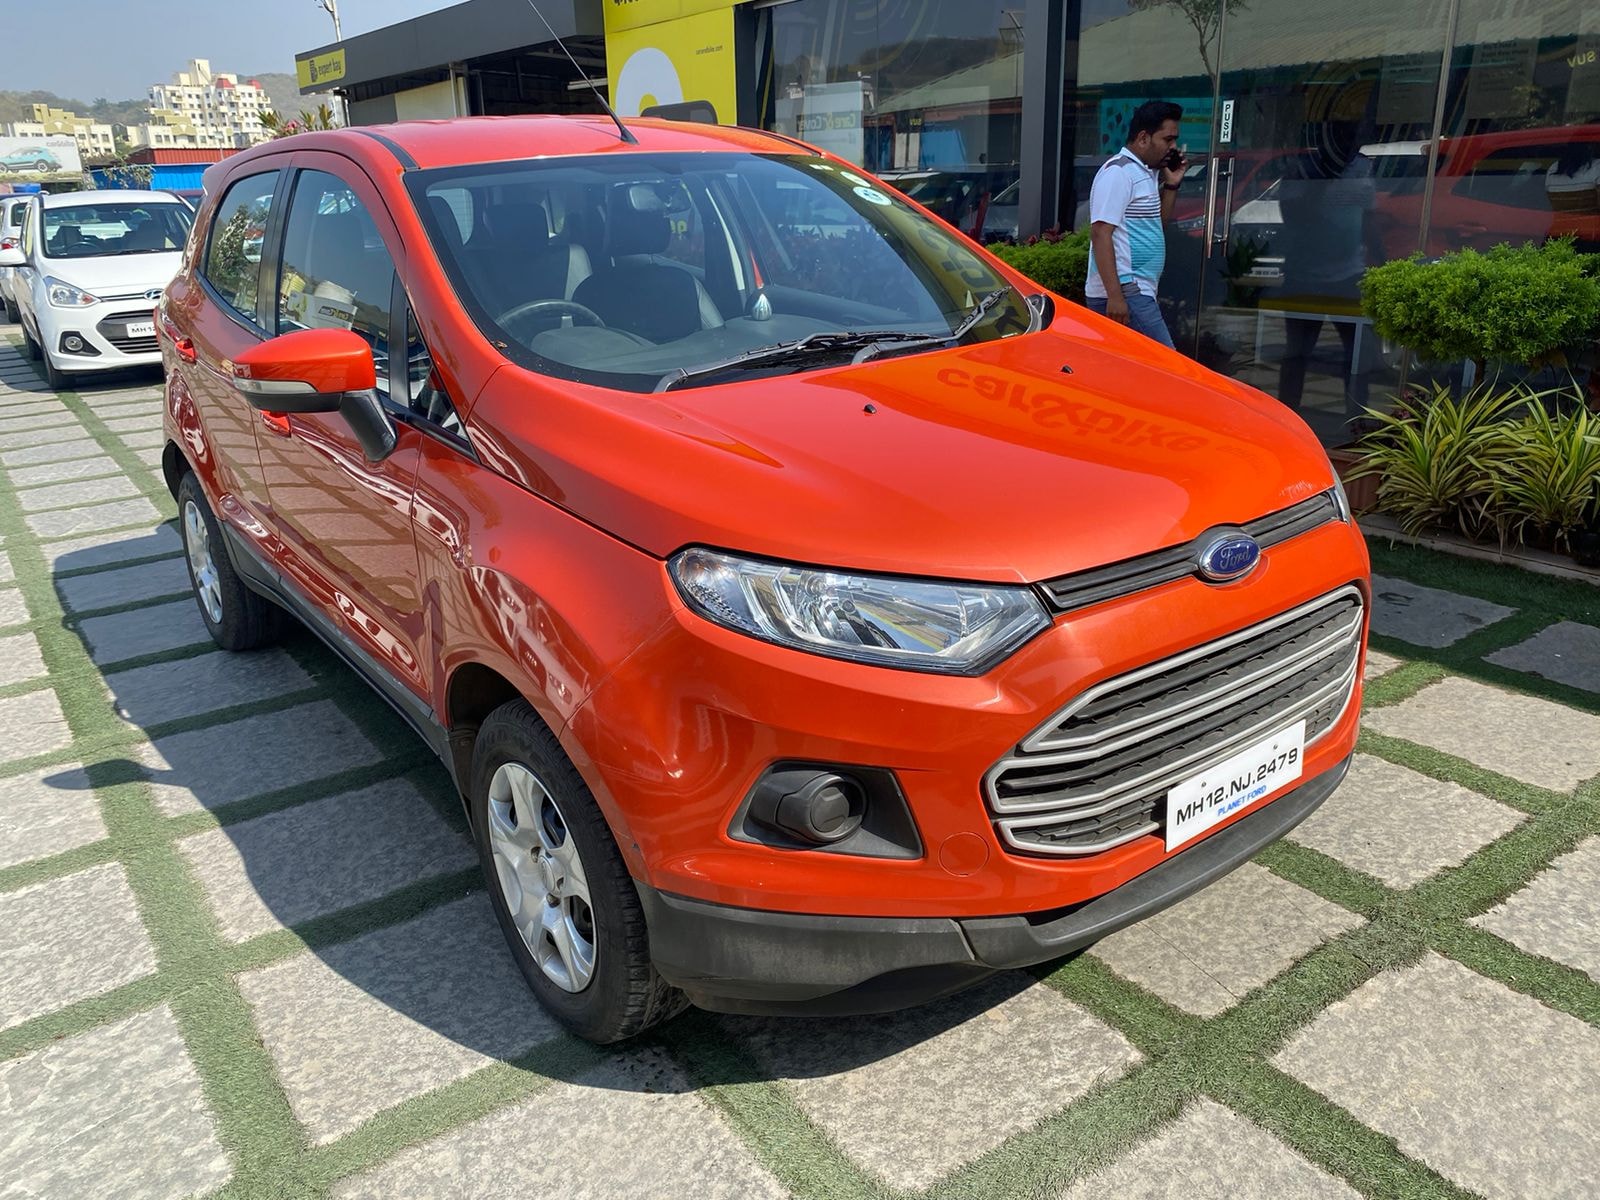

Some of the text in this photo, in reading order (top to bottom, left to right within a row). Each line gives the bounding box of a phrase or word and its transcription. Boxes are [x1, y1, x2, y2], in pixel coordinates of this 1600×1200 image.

[1223, 103, 1231, 140] PUSH
[1219, 544, 1250, 570] Ford
[1176, 747, 1299, 826] MH12.NJ.2479
[1217, 784, 1267, 817] PLANET FORD
